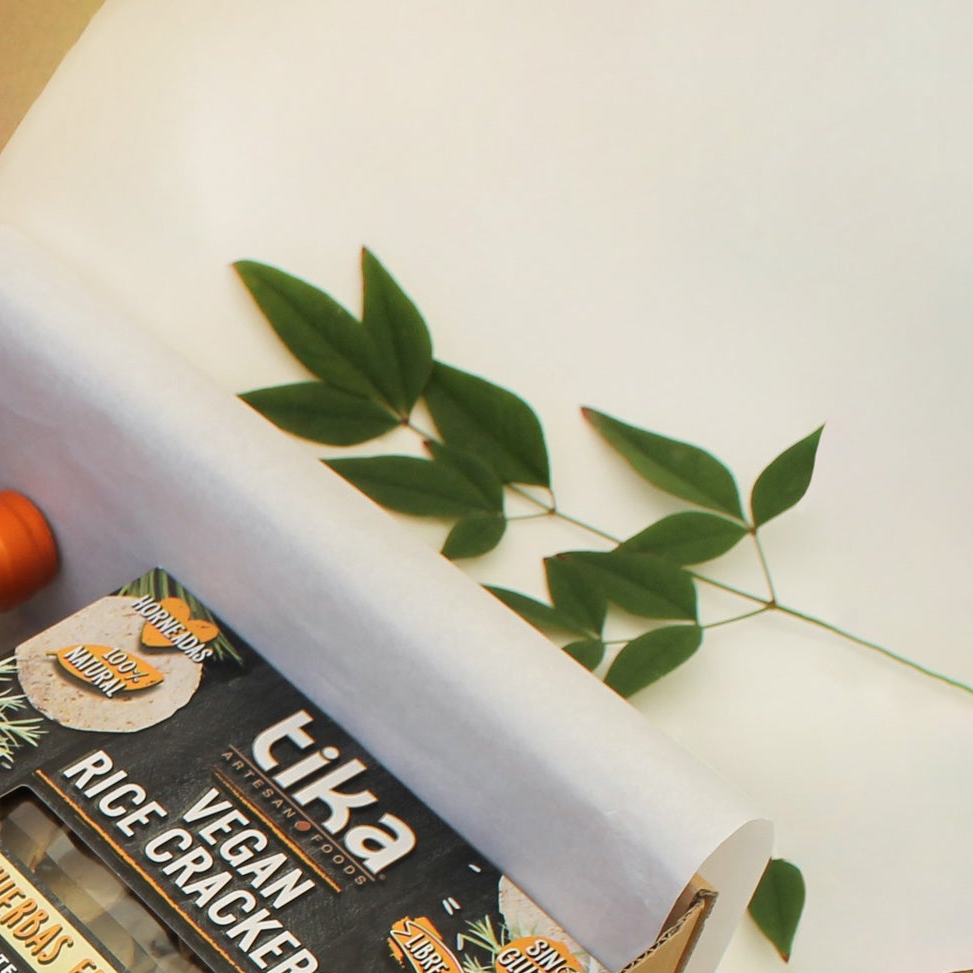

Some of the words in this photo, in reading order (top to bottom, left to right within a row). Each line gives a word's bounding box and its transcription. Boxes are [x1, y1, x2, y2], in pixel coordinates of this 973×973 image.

[102, 647, 148, 683] 100%
[131, 595, 213, 663] HORNEADAS
[65, 645, 126, 699] NATURAL
[62, 750, 167, 837] RICE
[221, 751, 295, 819] ARTESAN
[310, 834, 366, 886] FOODS
[252, 709, 416, 874] tika
[182, 787, 315, 910] VEGAN
[526, 939, 562, 973] SIN
